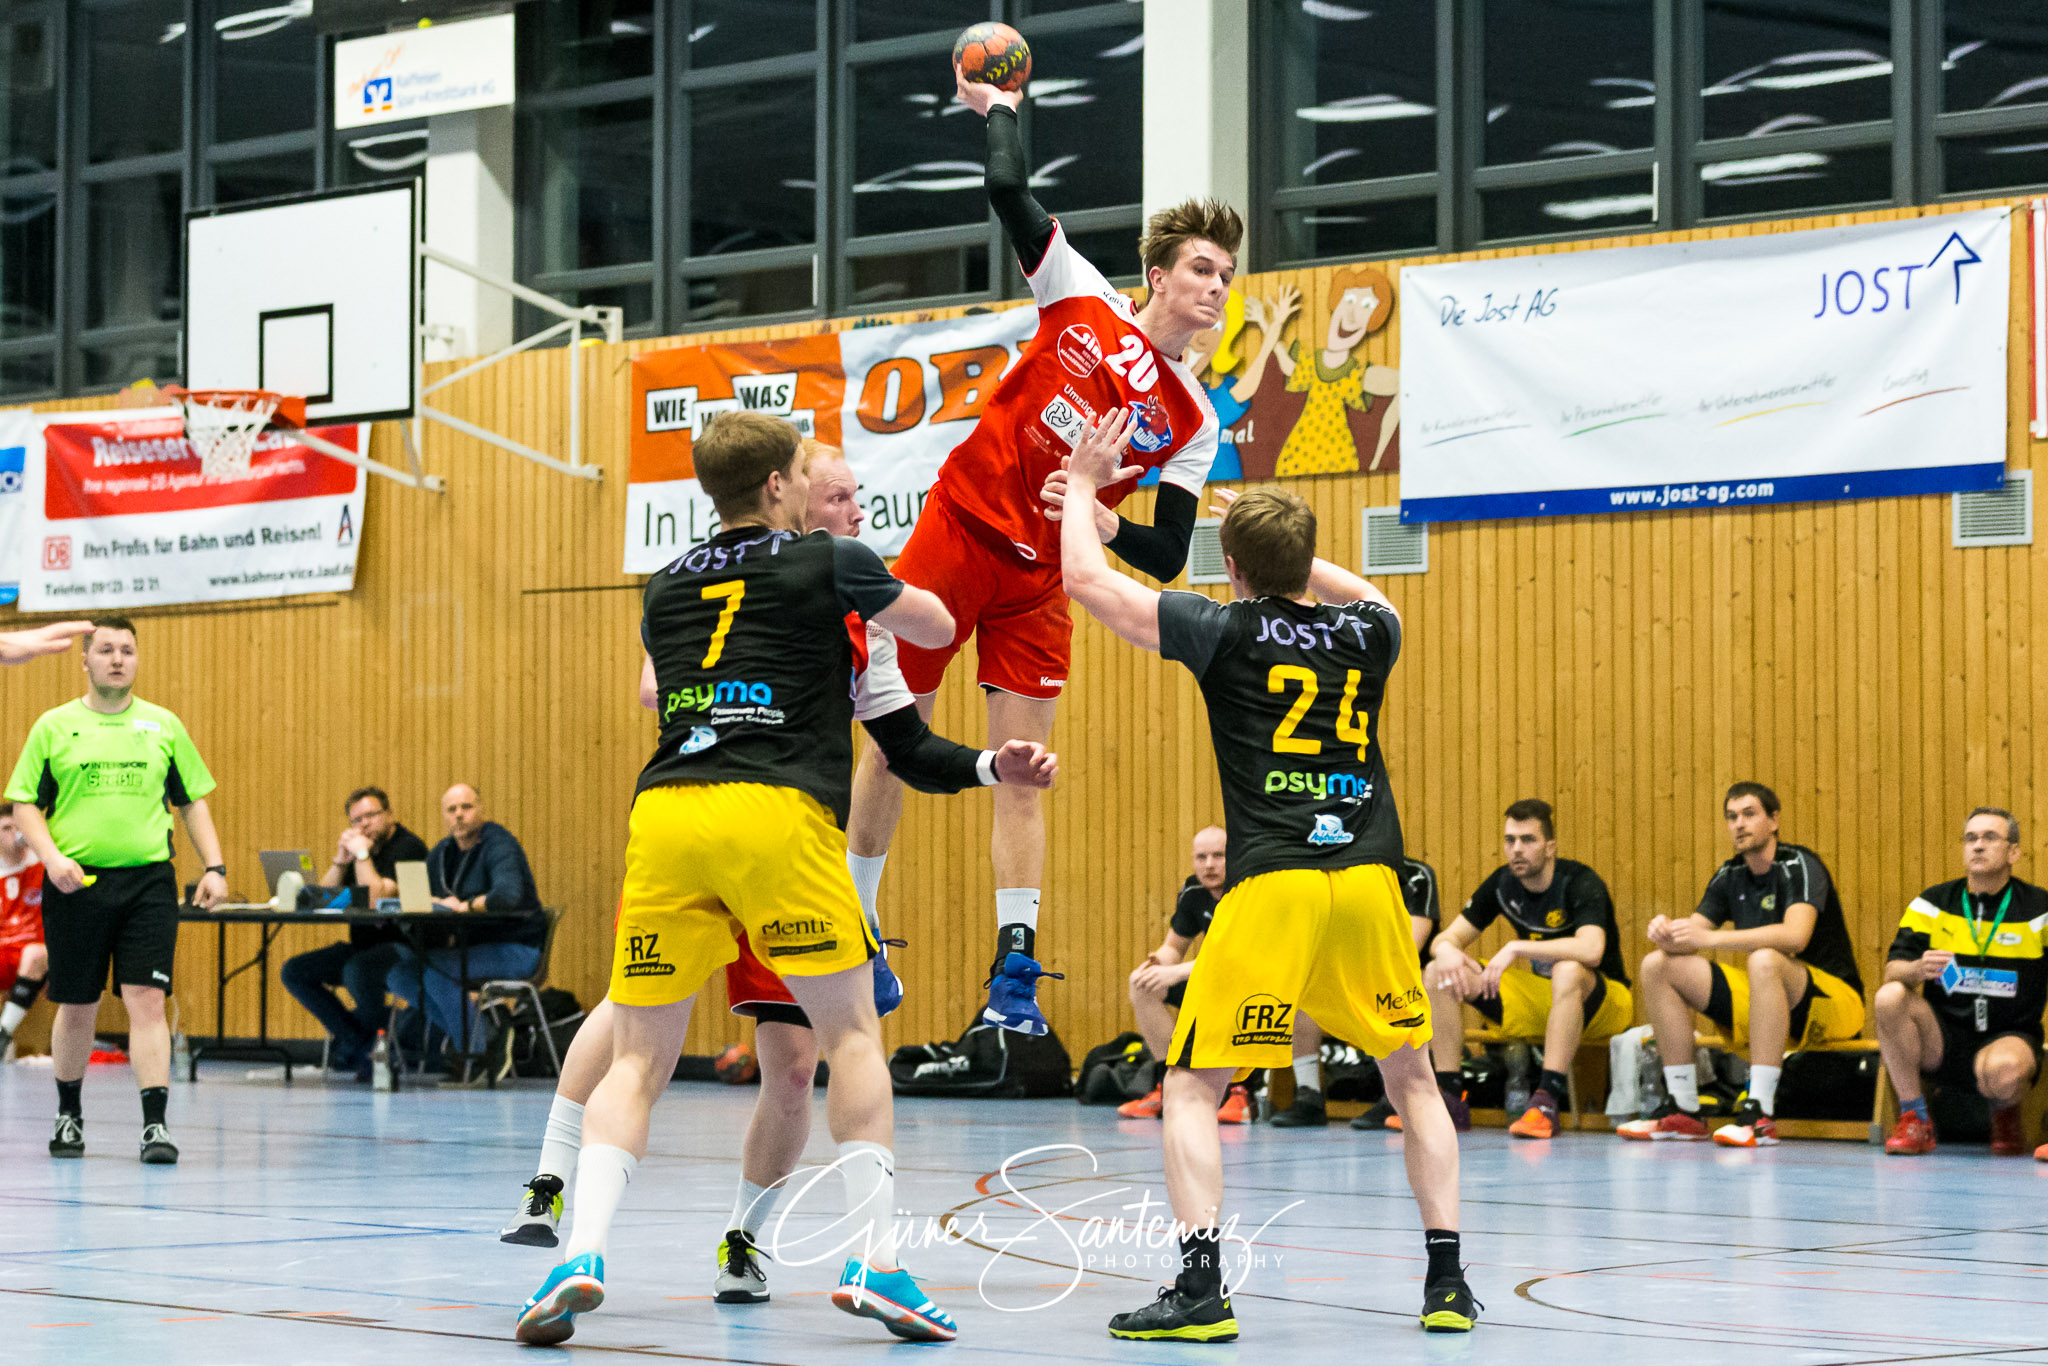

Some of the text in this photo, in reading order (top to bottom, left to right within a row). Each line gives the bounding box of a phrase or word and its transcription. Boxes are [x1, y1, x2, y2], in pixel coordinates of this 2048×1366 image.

[1440, 287, 1559, 327] Die Jost AG
[1814, 264, 1925, 318] JOST
[1105, 334, 1160, 392] 20
[740, 384, 789, 409] WAS
[856, 340, 1033, 434] OB
[1063, 383, 1095, 417] Umzüg
[653, 398, 687, 423] WIE
[1609, 482, 1775, 507] www.jost-ag.com
[111, 537, 150, 557] Profis
[179, 532, 219, 553] Bahn
[223, 527, 256, 548] und
[260, 522, 321, 545] Reisen!
[645, 501, 676, 547] In
[45, 540, 70, 567] DB
[669, 541, 748, 575] JOST
[701, 579, 746, 670] 7
[1256, 615, 1334, 650] JOST
[664, 680, 773, 723] psyma
[1267, 664, 1370, 763] 24
[91, 761, 148, 770] INTERSPORT
[762, 916, 834, 936] Mentis
[625, 932, 662, 962] RZ
[1376, 986, 1423, 1013] Metis
[1241, 1003, 1293, 1031] FRZ
